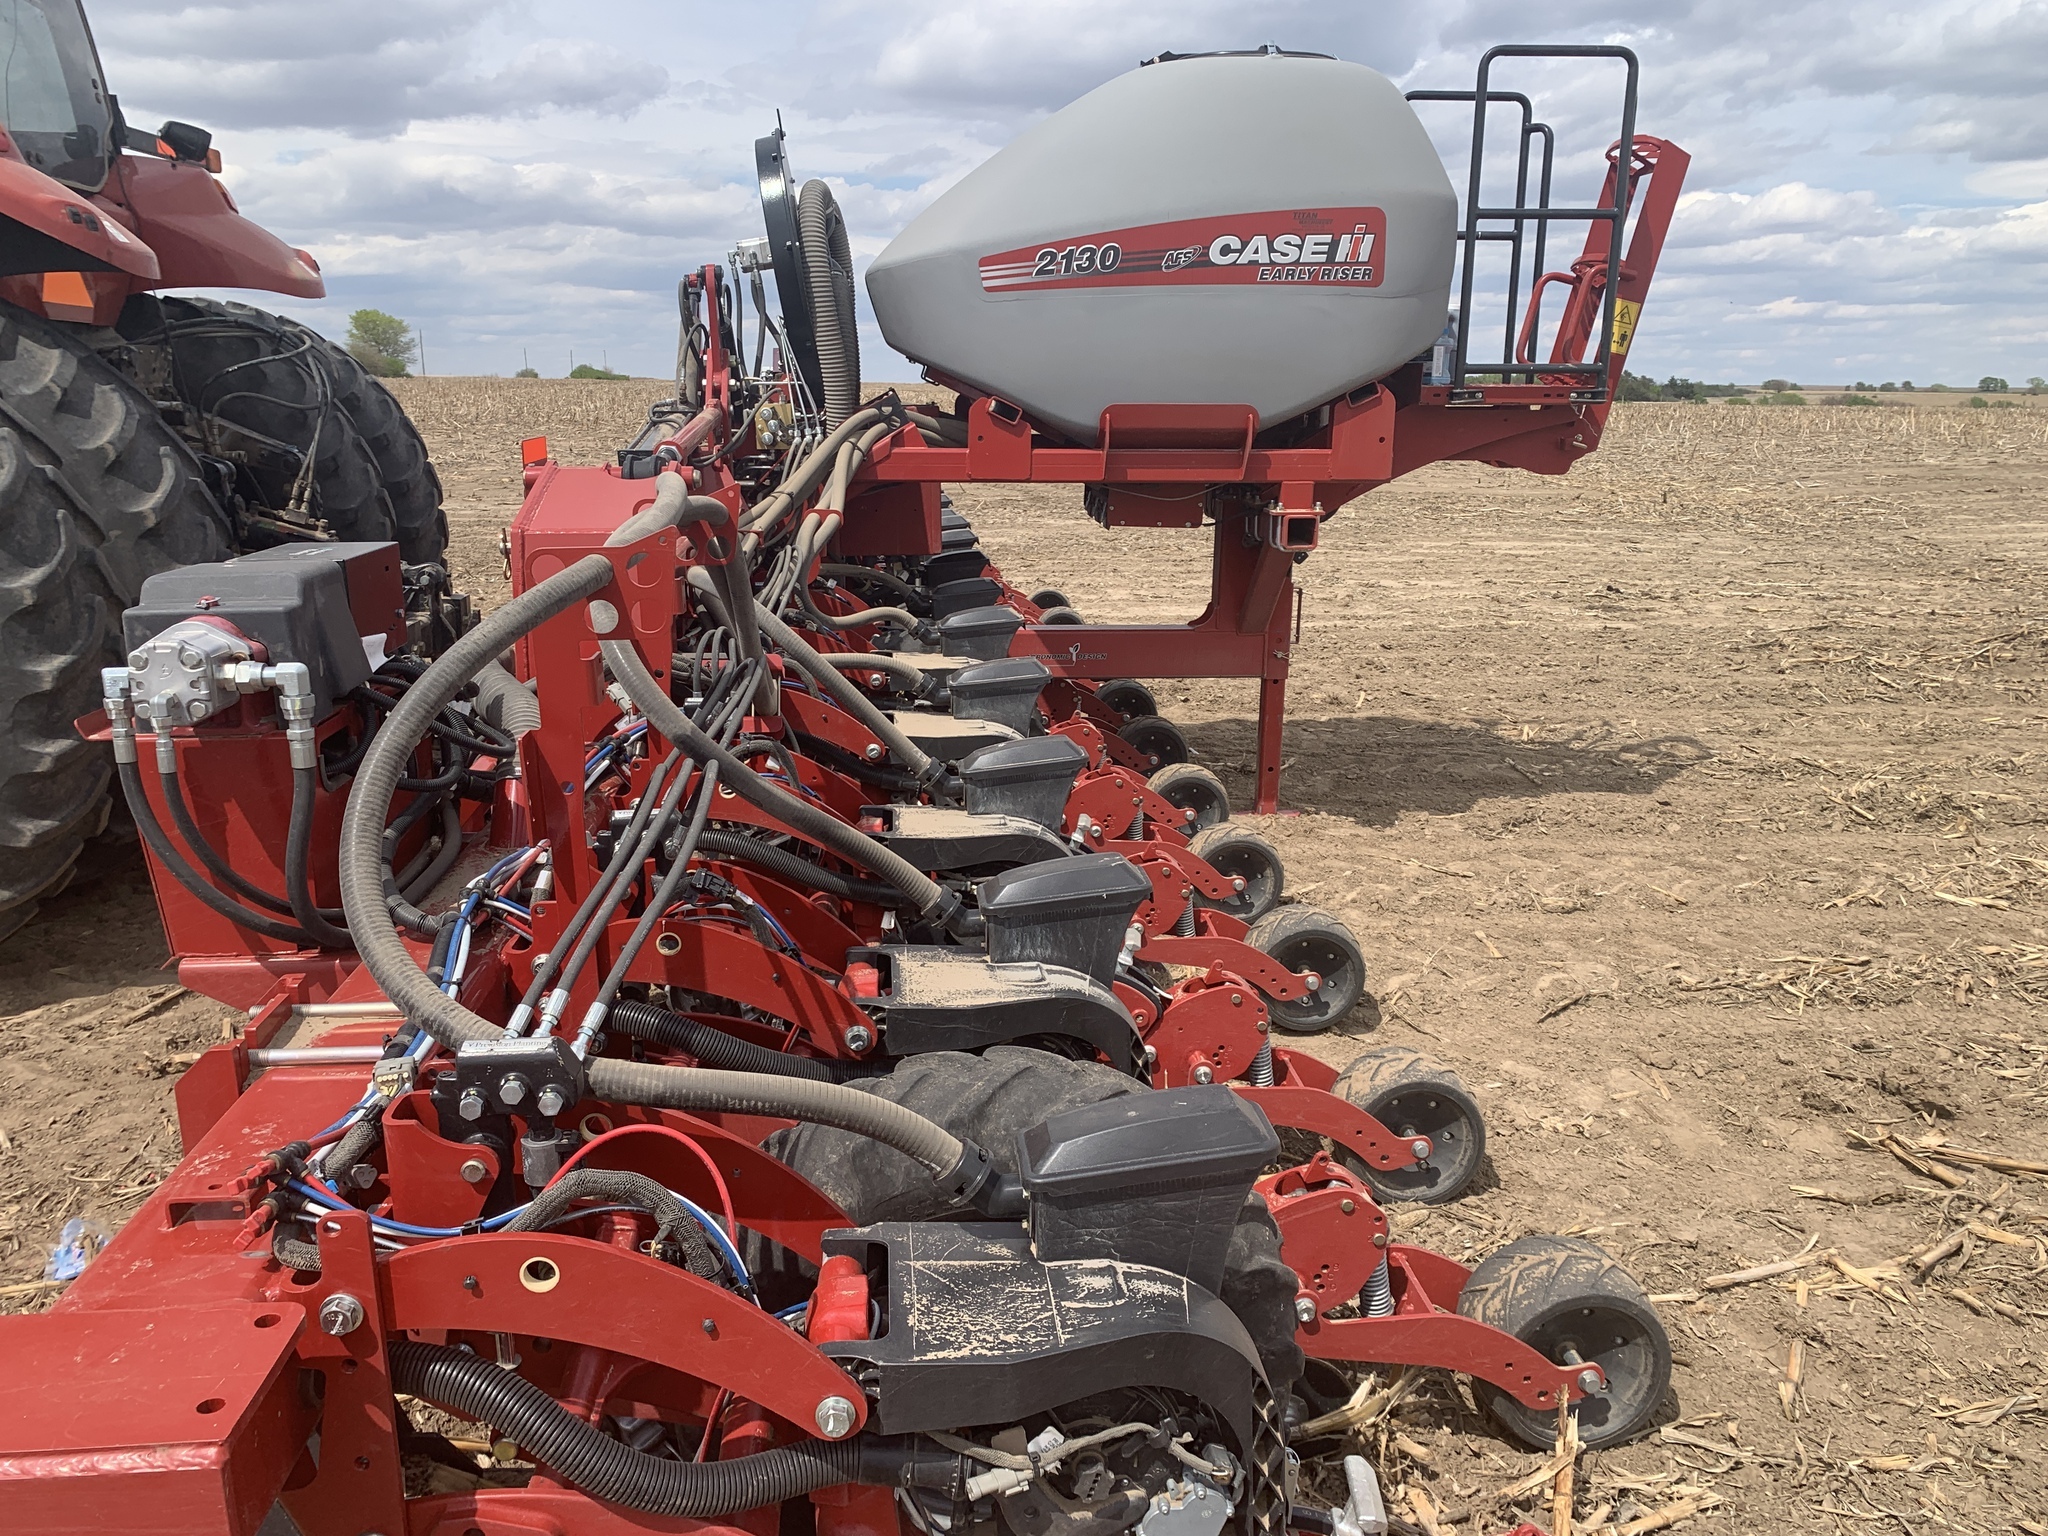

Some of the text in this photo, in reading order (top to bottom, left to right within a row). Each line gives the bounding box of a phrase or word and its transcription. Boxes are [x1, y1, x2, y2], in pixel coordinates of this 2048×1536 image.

[1293, 211, 1318, 220] TITAN
[1162, 249, 1196, 268] AFS
[1208, 235, 1333, 265] CASE
[1031, 243, 1122, 278] 2130
[1257, 266, 1374, 282] EARLY RISER
[1077, 652, 1108, 660] DESIGN
